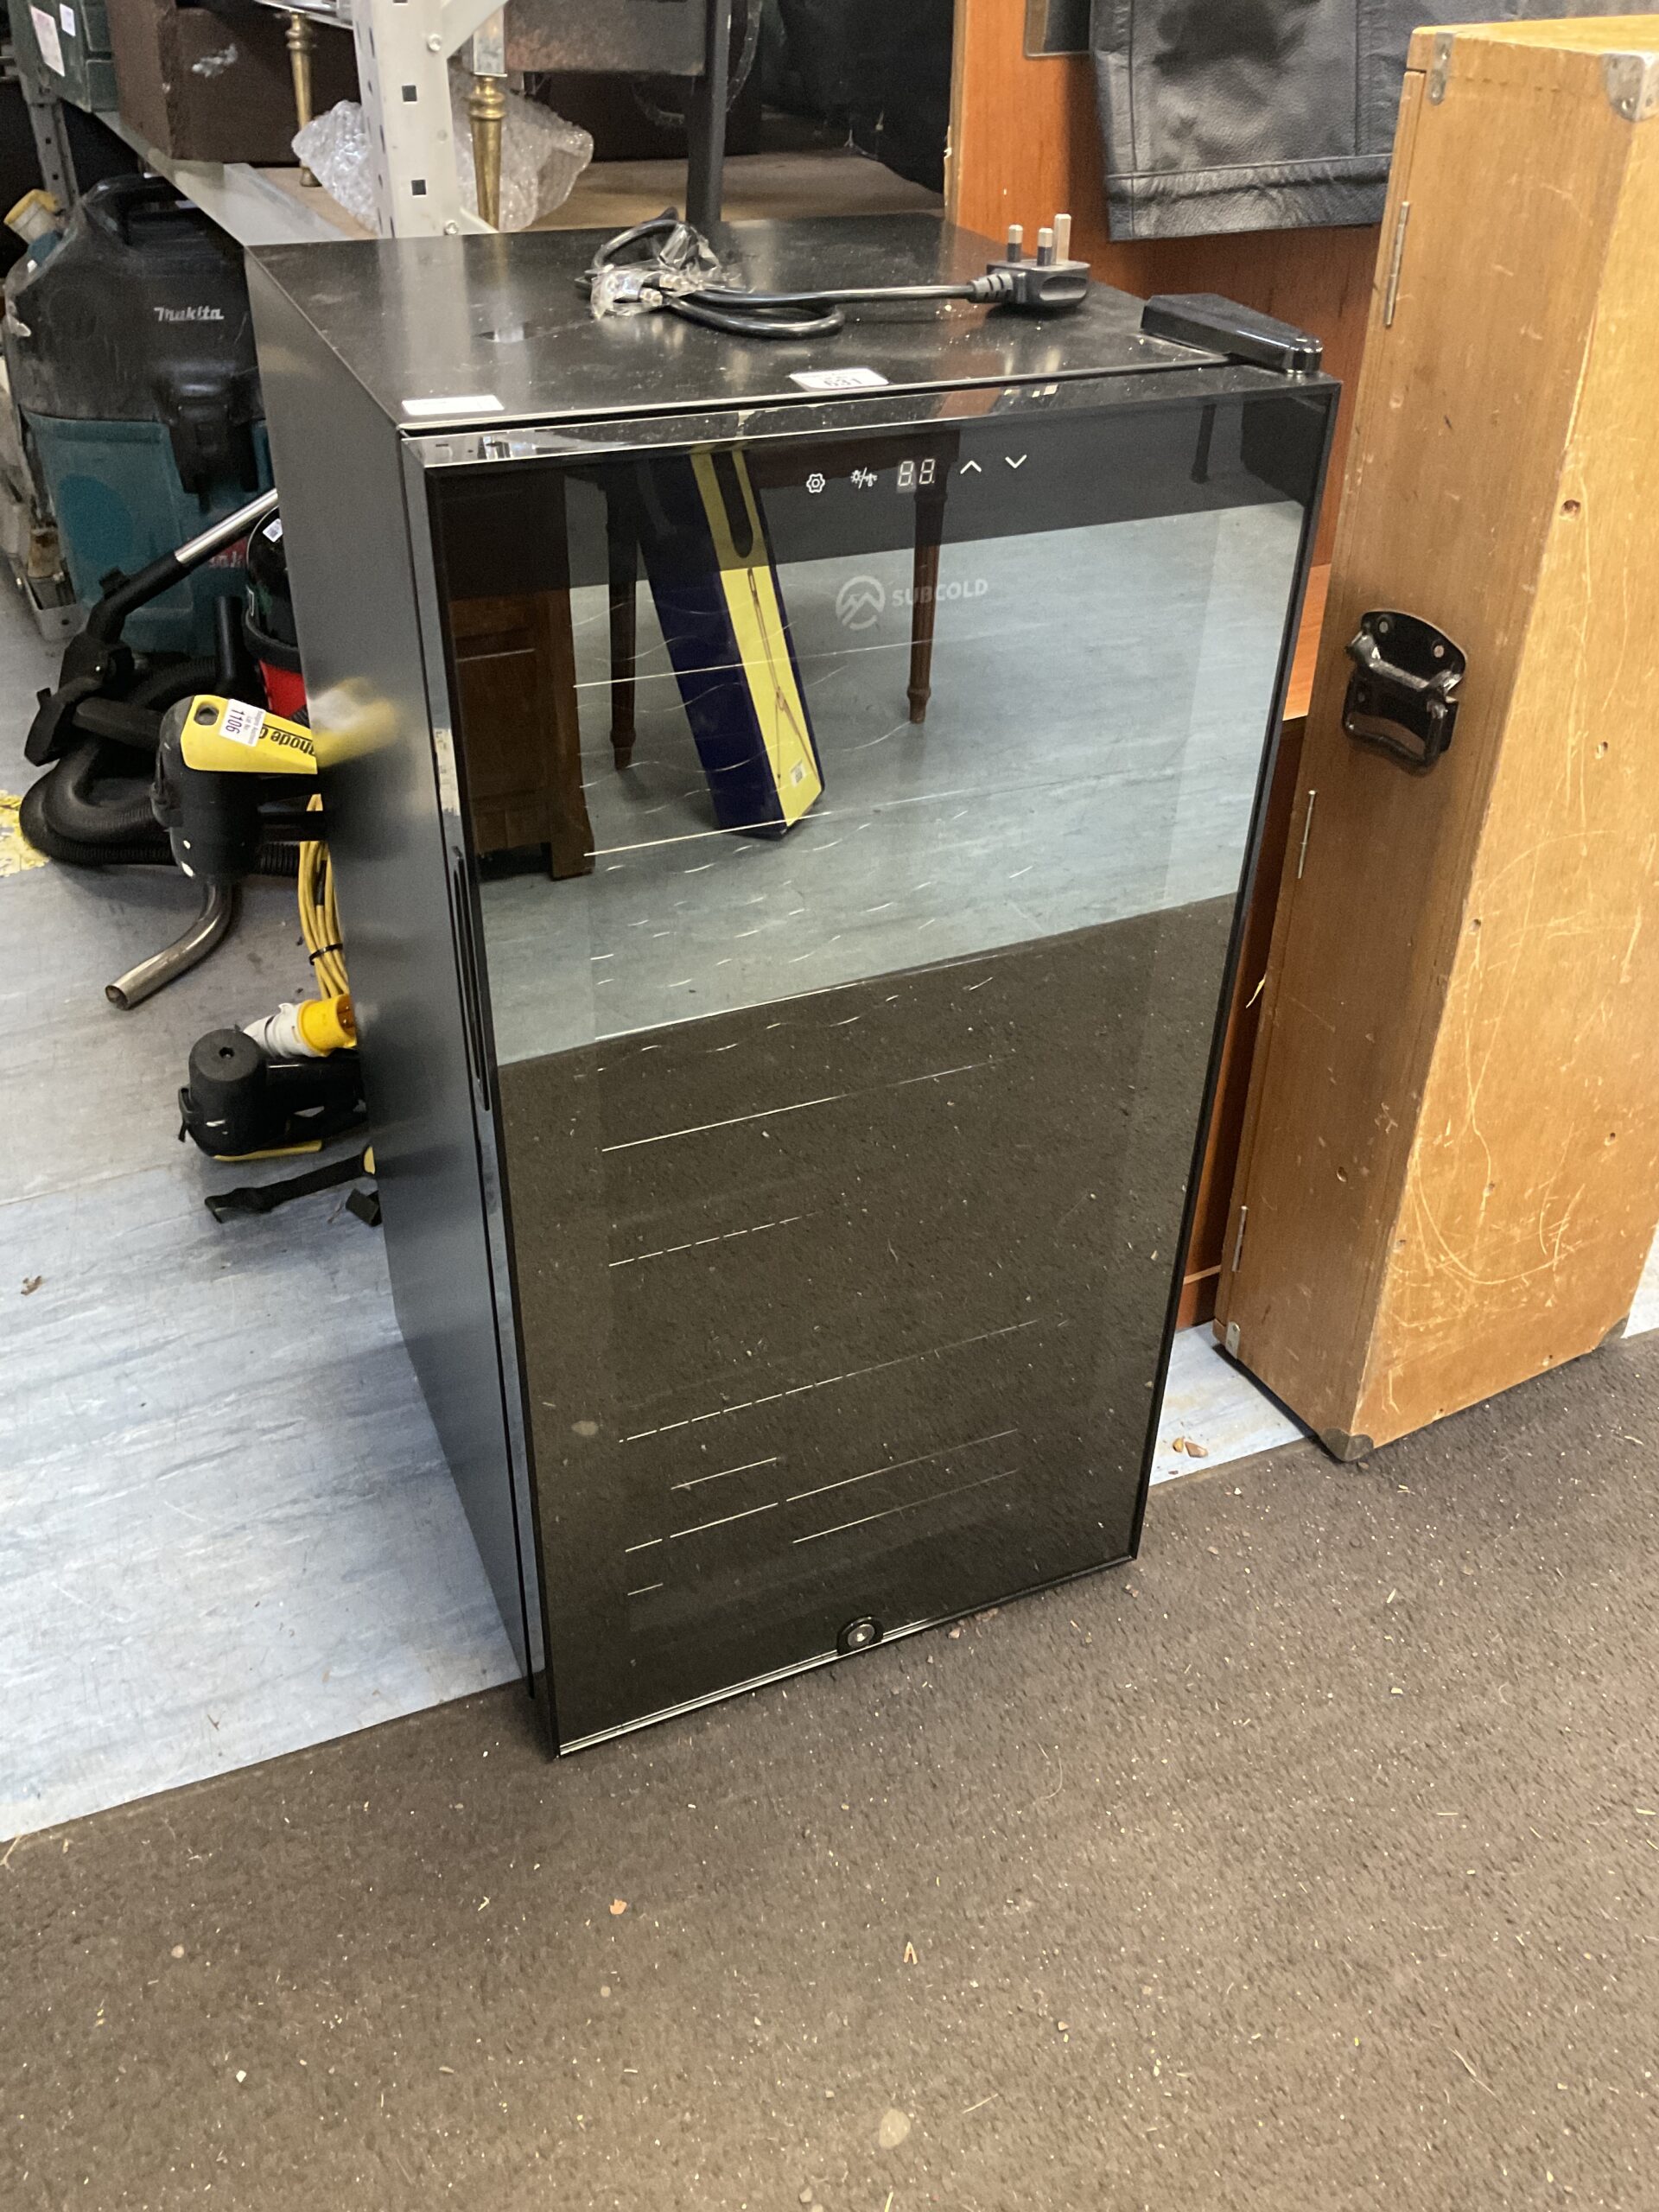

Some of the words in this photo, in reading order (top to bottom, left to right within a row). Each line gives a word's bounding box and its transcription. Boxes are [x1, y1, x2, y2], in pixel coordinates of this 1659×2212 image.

[154, 305, 225, 321] Makita
[891, 578, 988, 607] SUBCOLD
[225, 709, 246, 734] 1106
